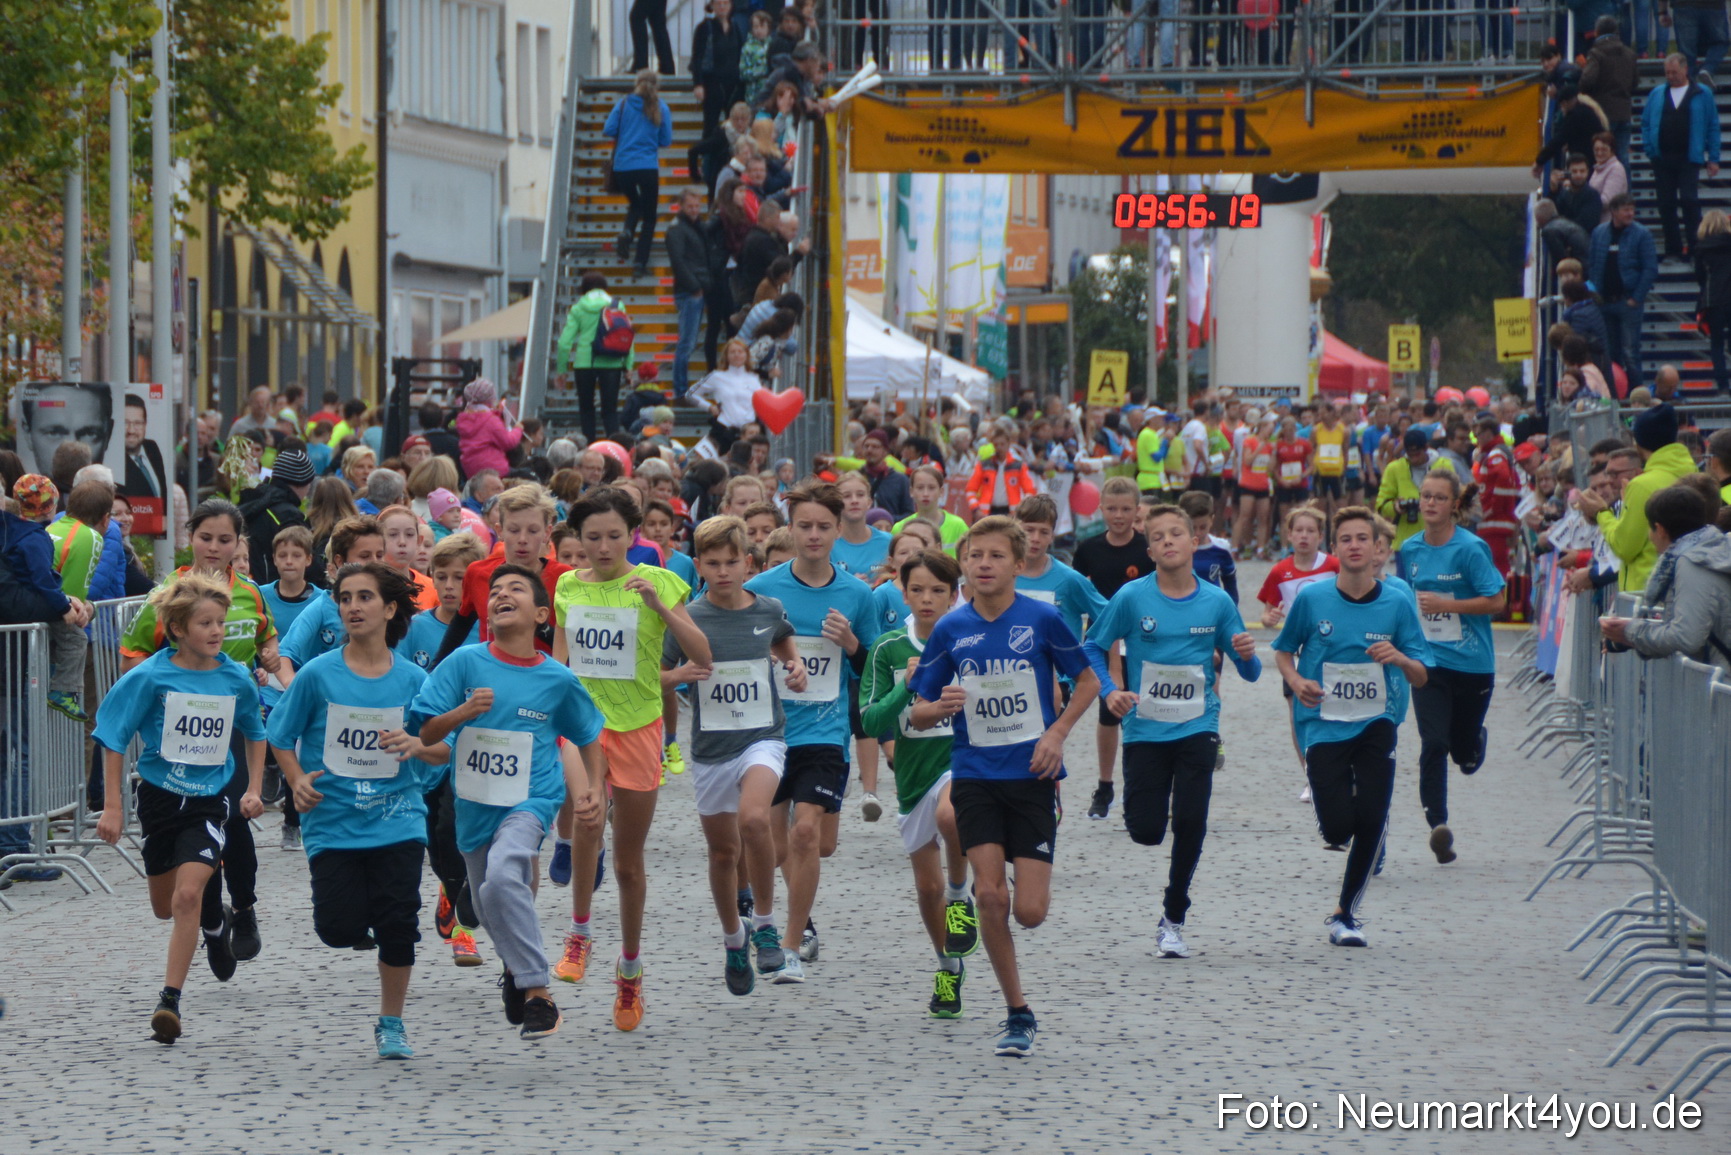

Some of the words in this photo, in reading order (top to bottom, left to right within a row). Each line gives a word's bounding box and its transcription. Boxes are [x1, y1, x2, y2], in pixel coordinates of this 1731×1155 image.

[1117, 107, 1271, 158] ZIEL
[1397, 340, 1412, 361] B
[1098, 369, 1116, 393] A
[575, 627, 625, 651] 4004
[1189, 626, 1217, 634] BOCK
[1365, 632, 1393, 641] BOCK
[581, 656, 594, 665] Luca
[595, 657, 618, 668] Ronja
[710, 681, 759, 704] 4001
[1148, 681, 1195, 700] 4040
[1331, 681, 1377, 700] 4036
[517, 707, 549, 721] BOCK
[731, 710, 744, 718] Tim
[975, 692, 1028, 719] 4005
[174, 714, 225, 738] 4099
[986, 722, 1024, 734] Alexander
[178, 744, 218, 755] MARVIN
[346, 756, 378, 767] Radwan
[466, 749, 519, 777] 4033
[353, 780, 377, 794] 18.
